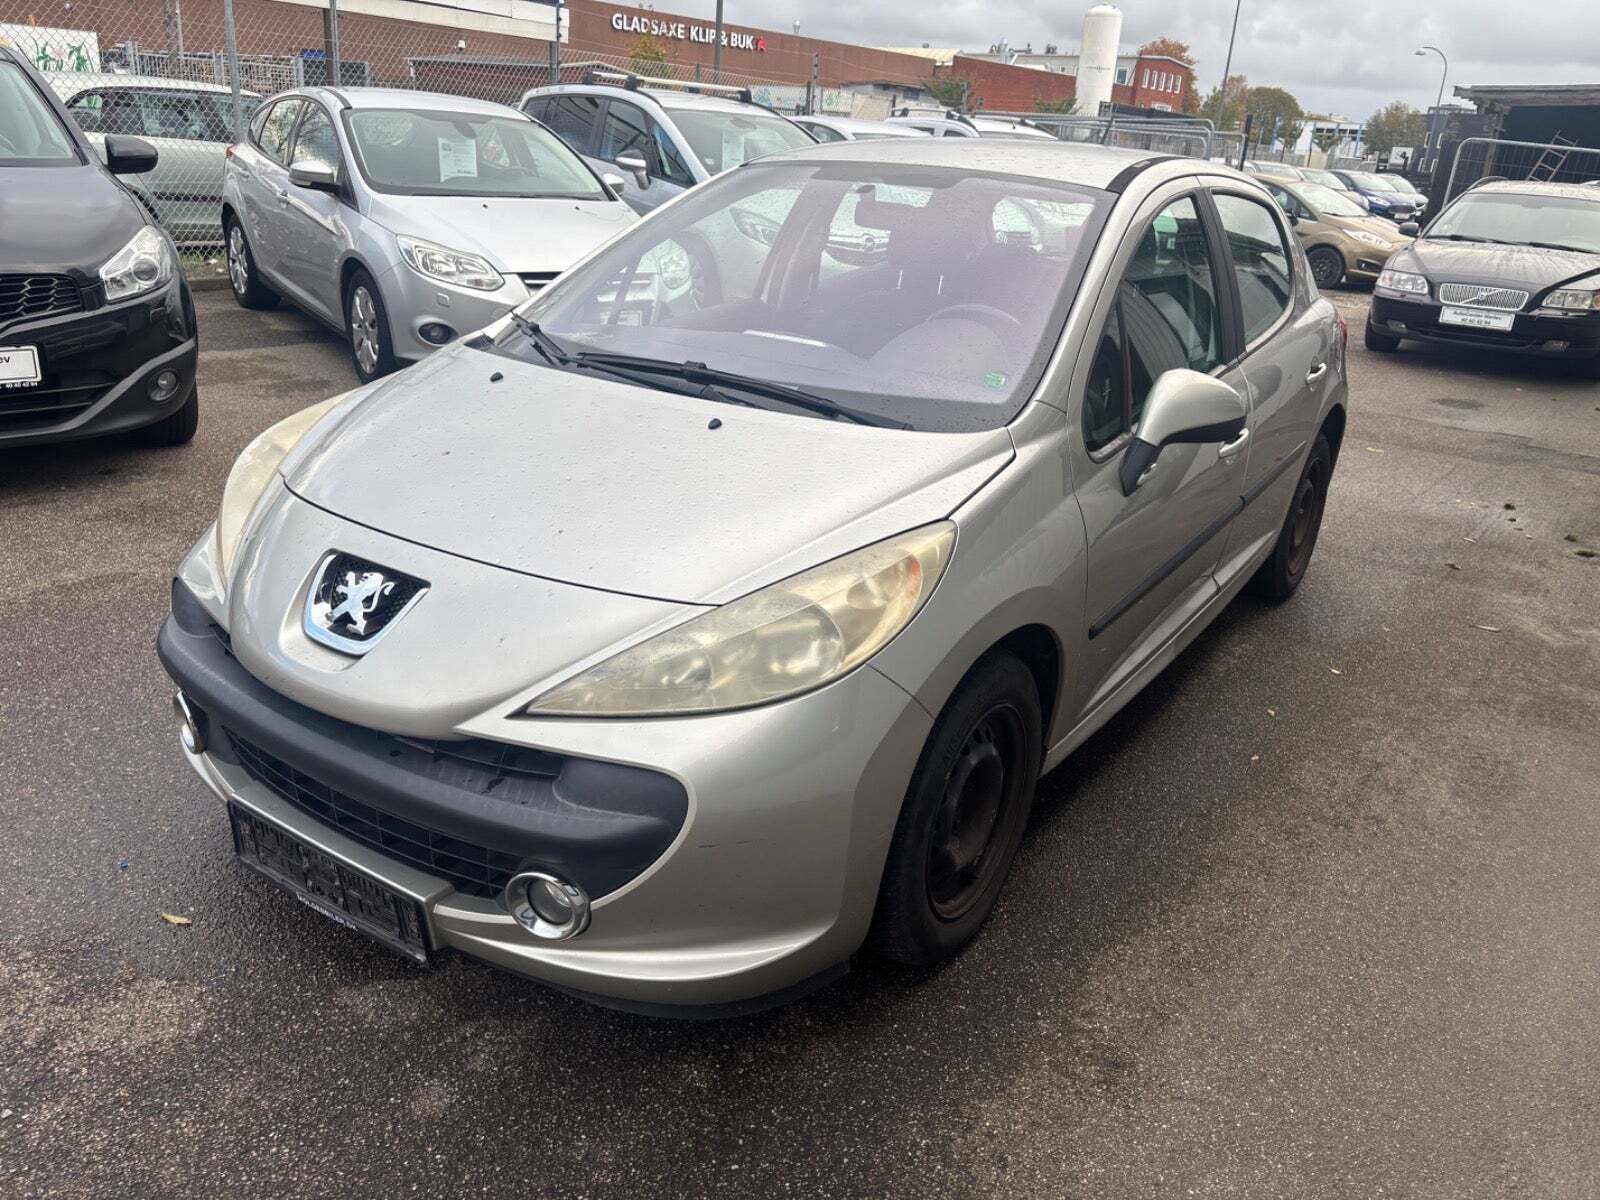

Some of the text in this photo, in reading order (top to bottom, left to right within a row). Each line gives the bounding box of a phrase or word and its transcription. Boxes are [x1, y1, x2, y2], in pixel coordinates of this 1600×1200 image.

[612, 13, 685, 38] GLADSAXE
[690, 26, 716, 43] KLIP
[731, 33, 754, 49] BUK
